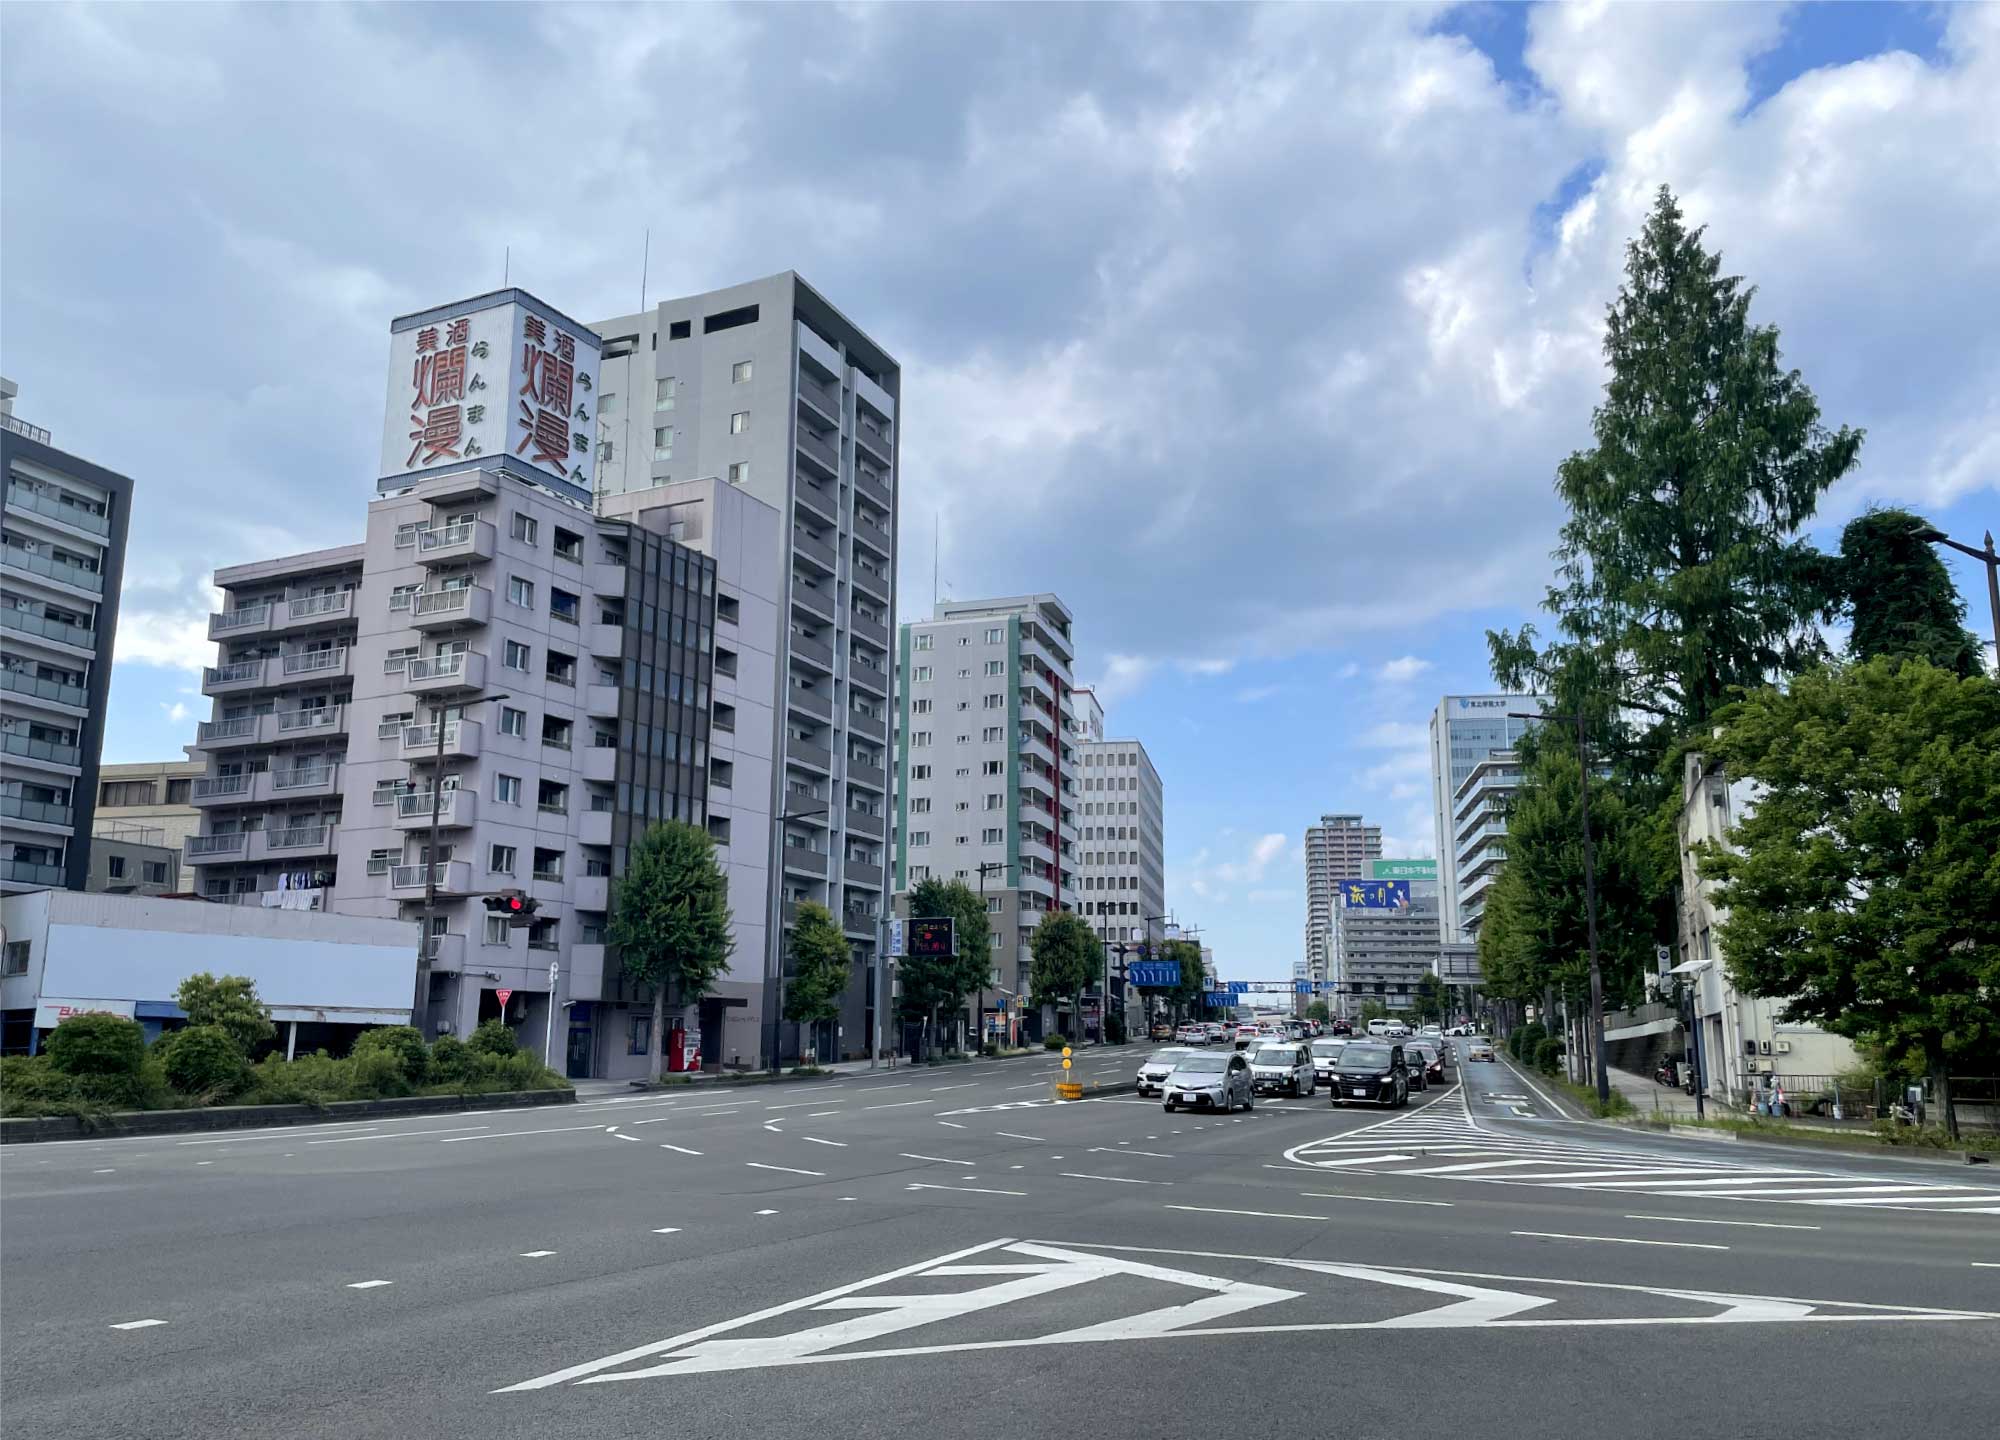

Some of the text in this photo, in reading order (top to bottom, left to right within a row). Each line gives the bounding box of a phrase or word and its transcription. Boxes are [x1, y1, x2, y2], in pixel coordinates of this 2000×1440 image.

[416, 318, 470, 354] 美酒
[523, 315, 576, 363] 美酒
[406, 345, 468, 468] 爛漫
[464, 341, 490, 457] らんまん
[516, 343, 575, 476] 爛漫
[570, 371, 592, 483] らんまん
